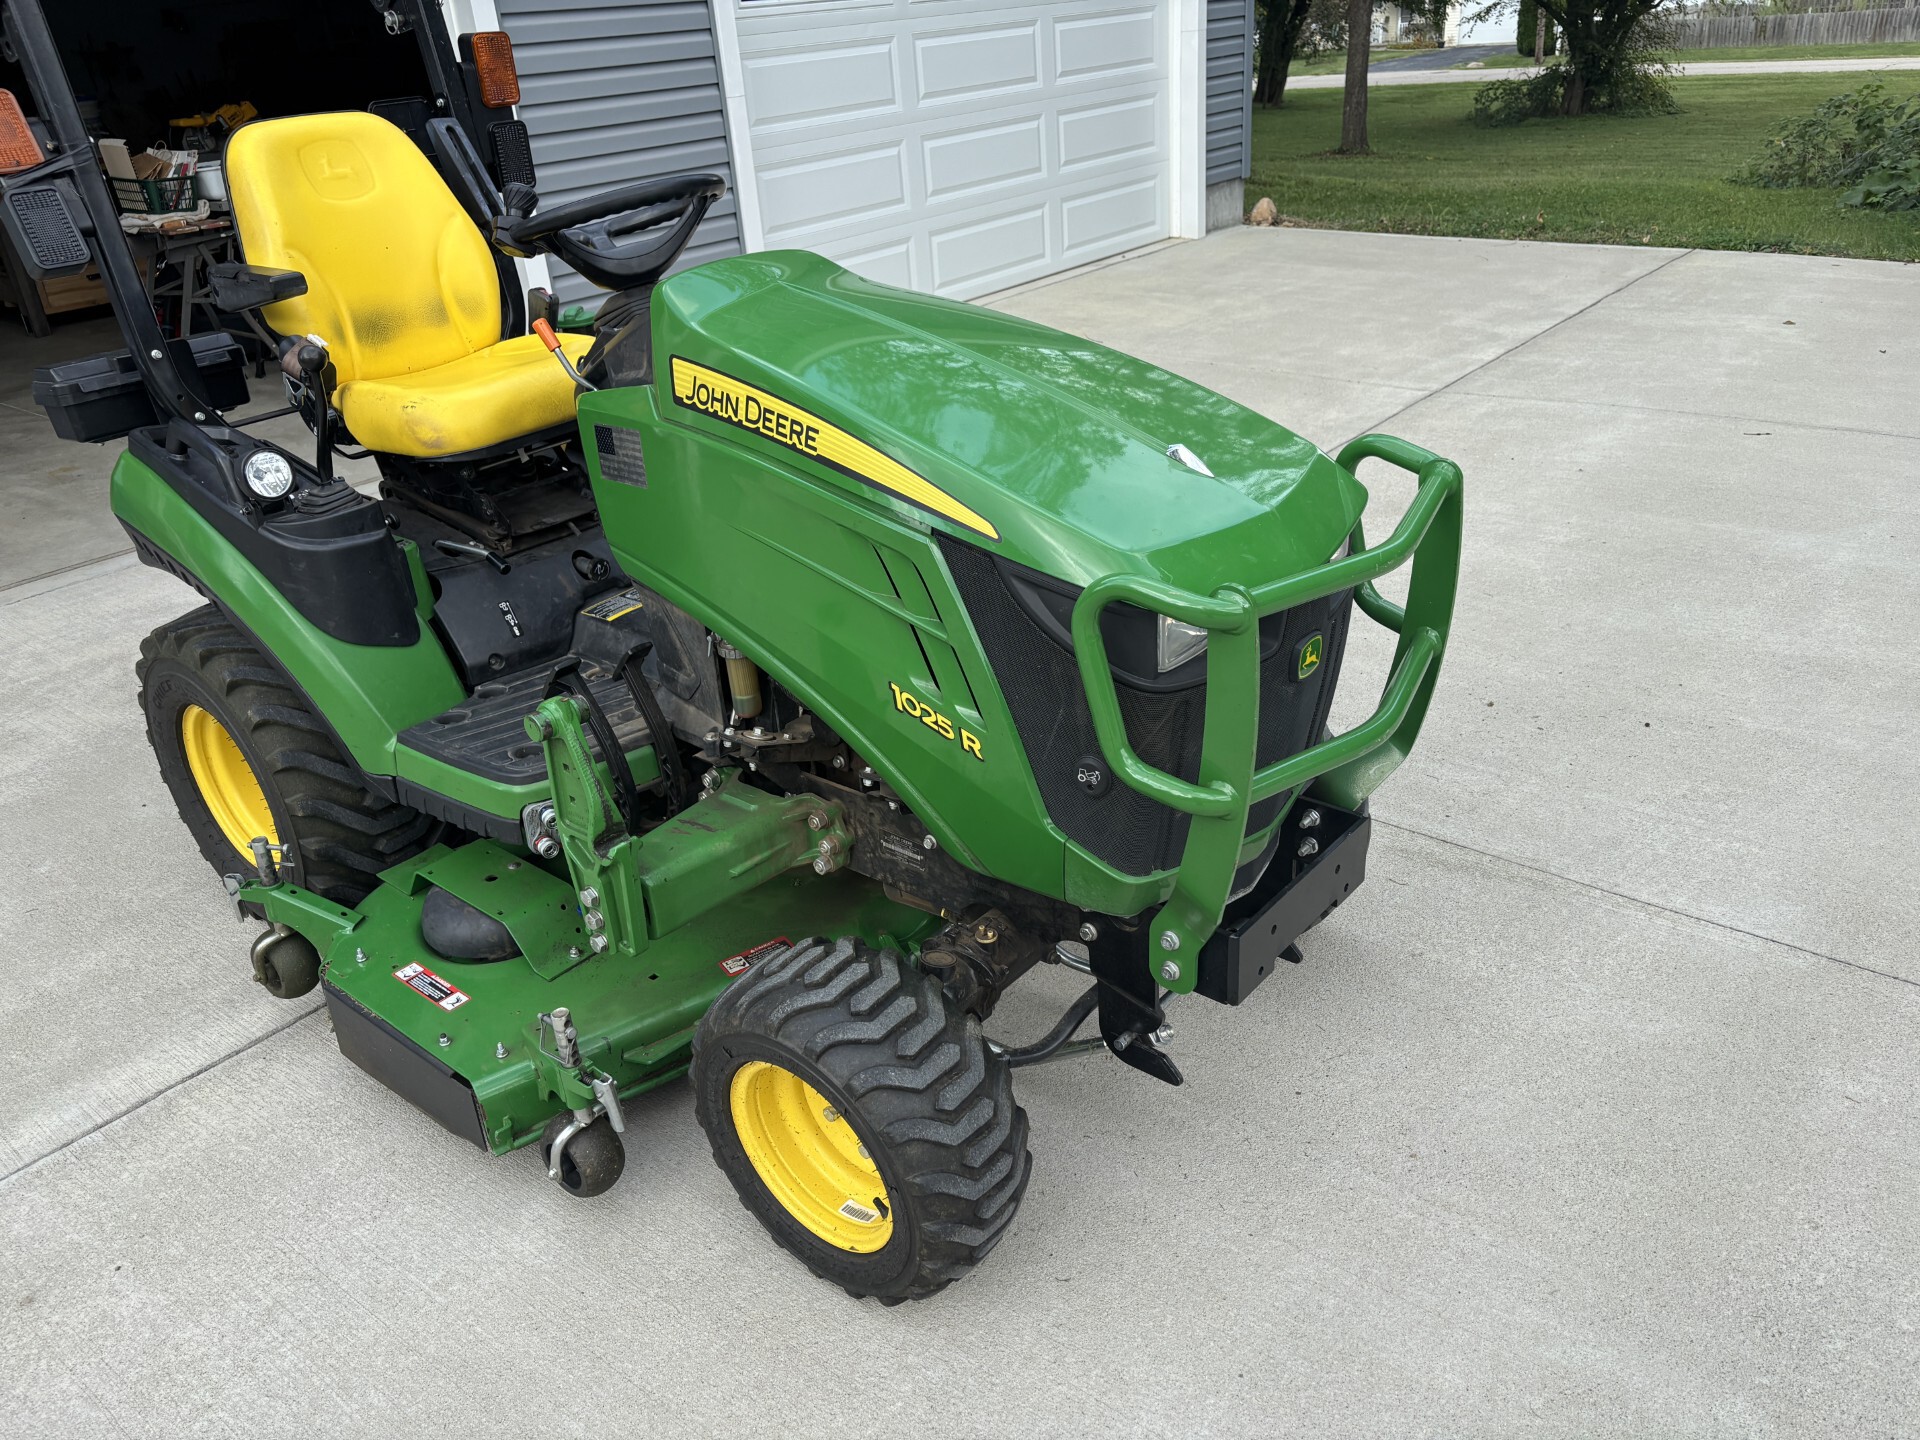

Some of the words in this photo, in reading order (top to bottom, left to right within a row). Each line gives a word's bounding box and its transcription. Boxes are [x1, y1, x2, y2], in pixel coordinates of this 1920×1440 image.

[685, 375, 740, 422] JOHN
[743, 395, 820, 454] DEERE
[888, 680, 955, 741] 1025
[959, 727, 985, 761] R
